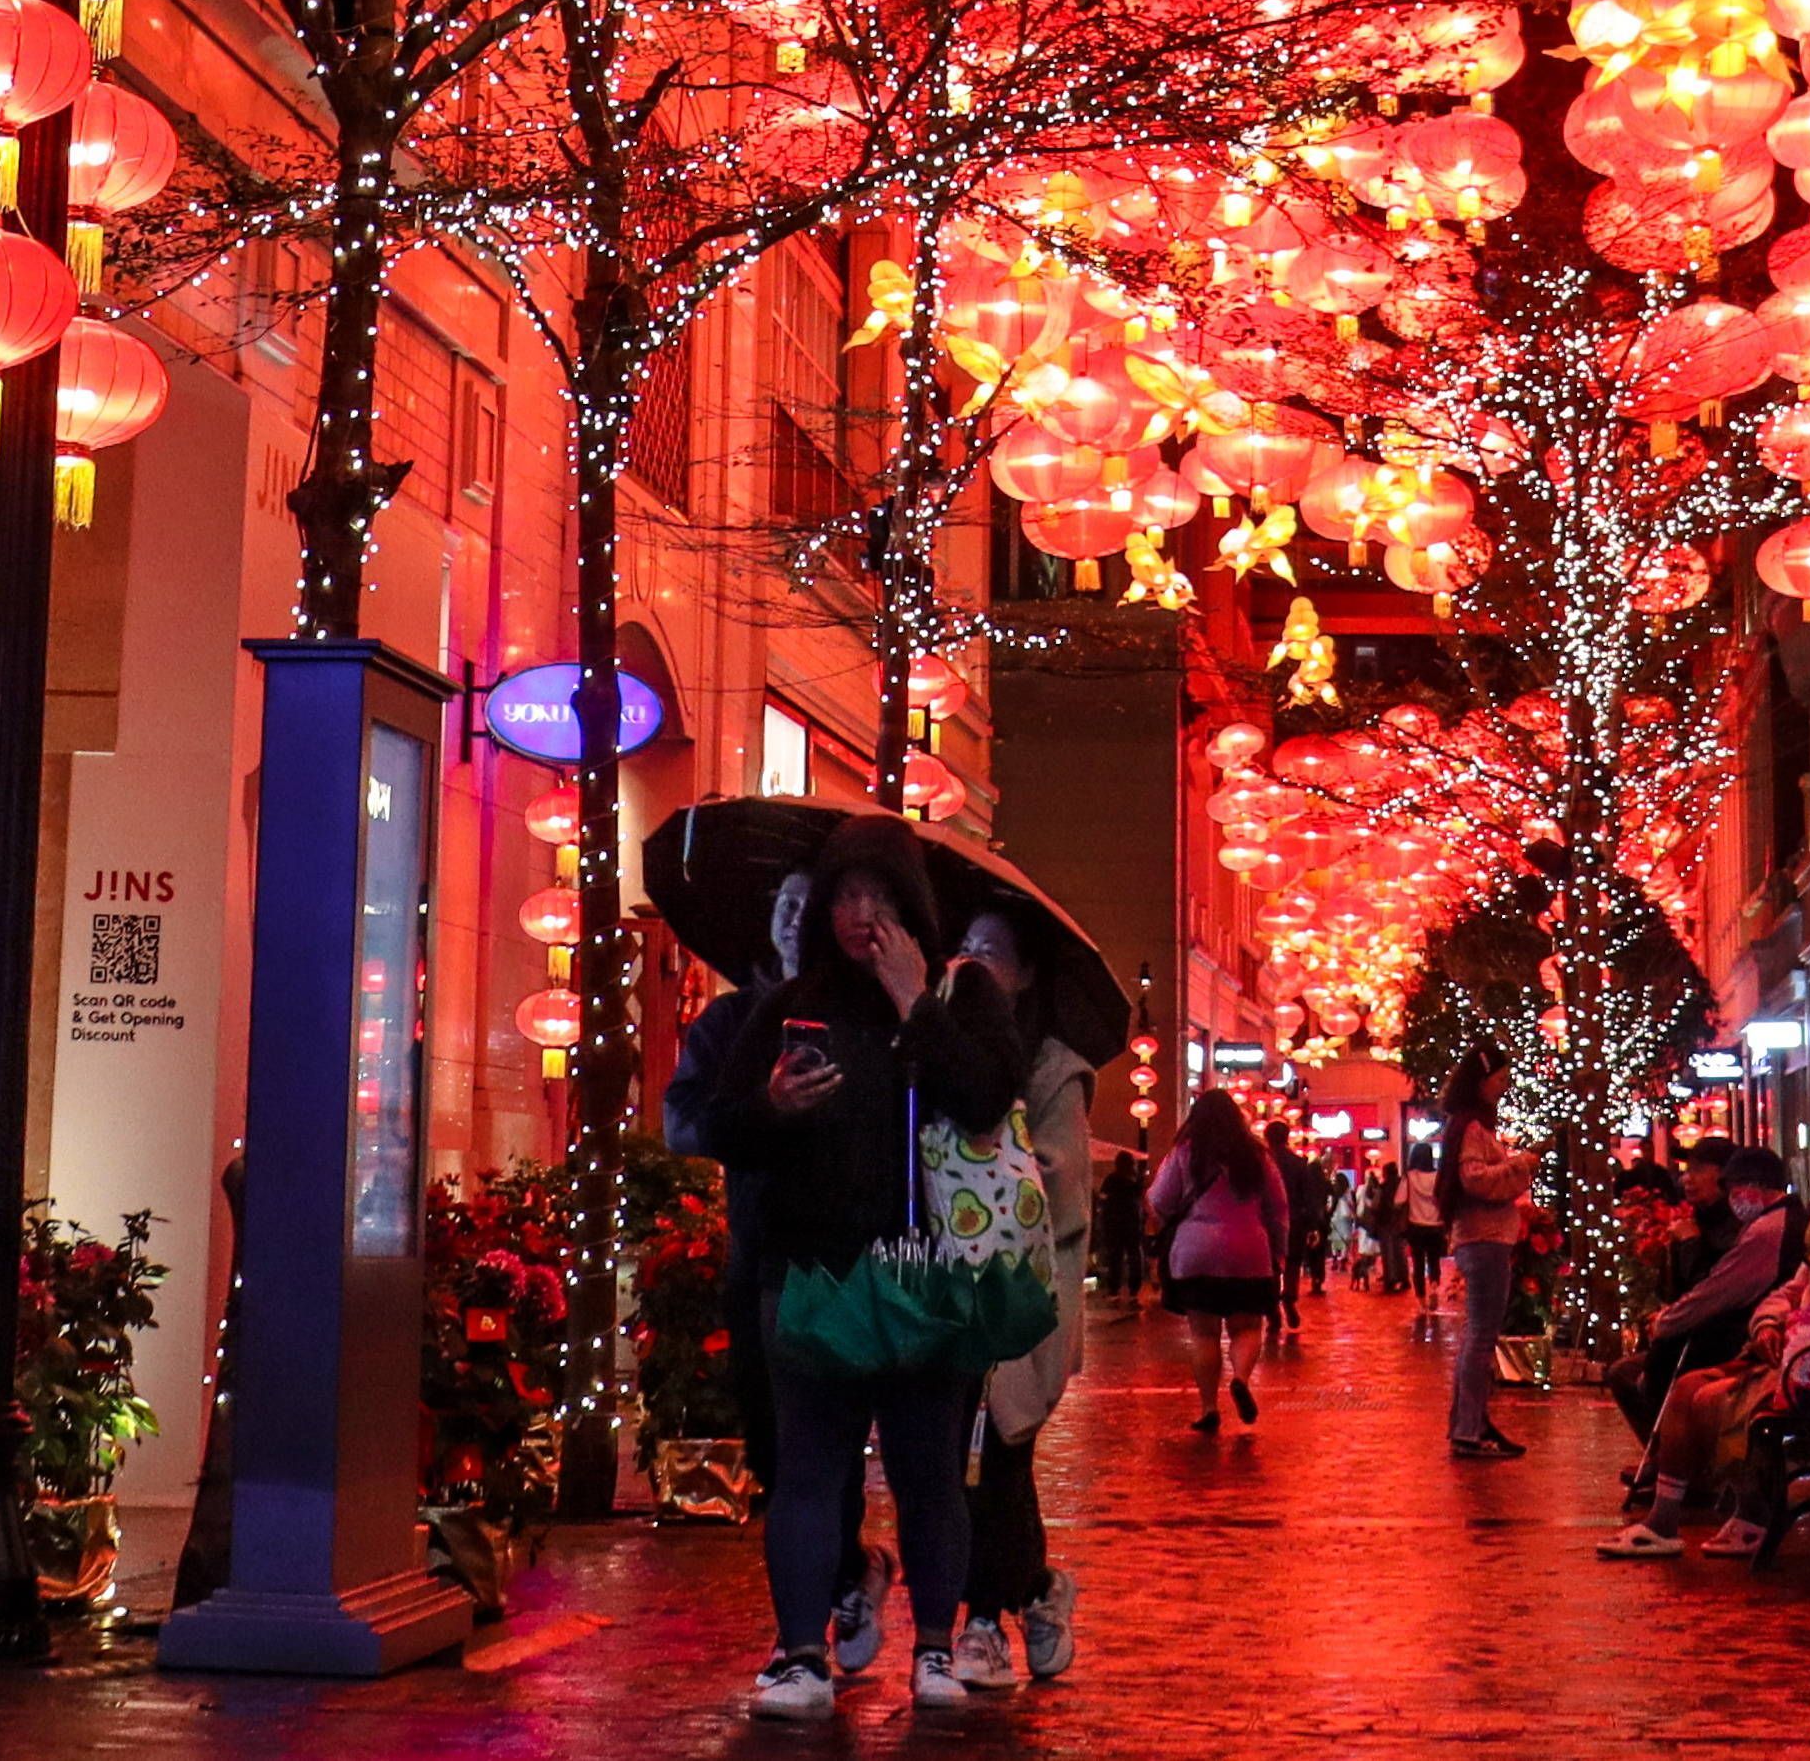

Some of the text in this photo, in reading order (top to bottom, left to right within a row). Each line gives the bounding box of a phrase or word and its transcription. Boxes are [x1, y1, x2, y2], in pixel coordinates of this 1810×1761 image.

[72, 993, 176, 1008] Scan QR code
[72, 1011, 185, 1029] & Get Opening
[71, 1027, 136, 1042] Discount
